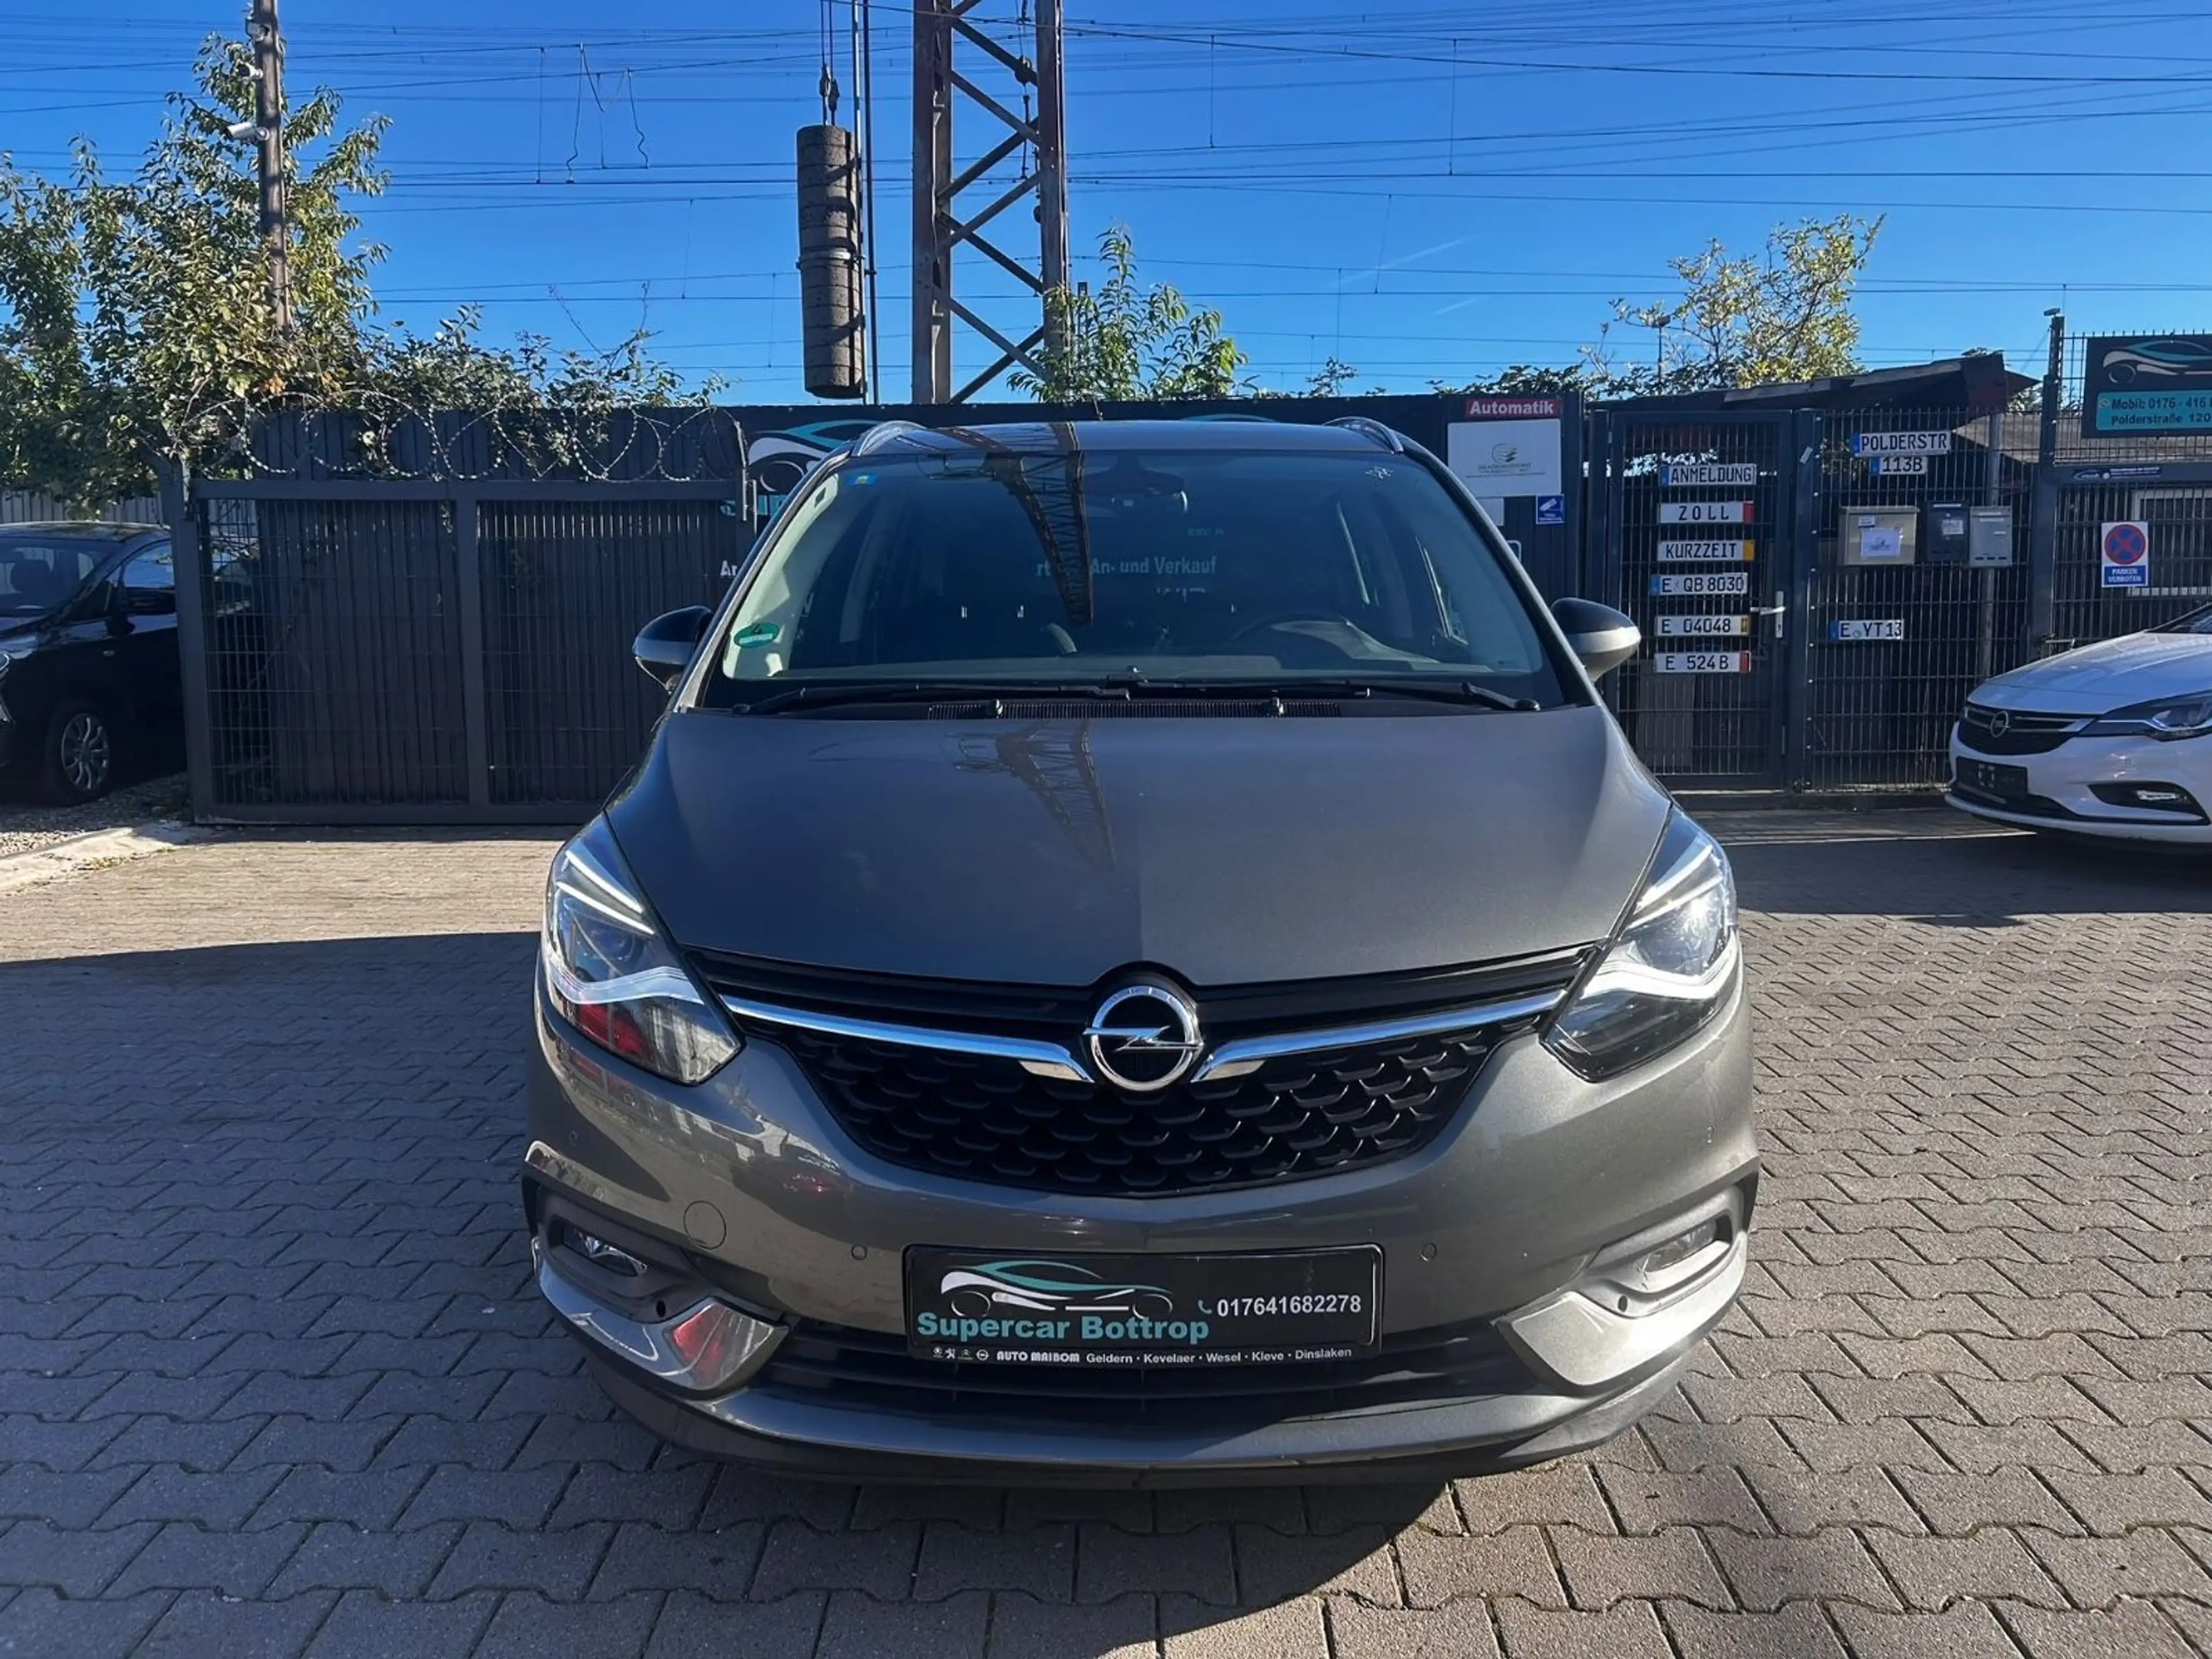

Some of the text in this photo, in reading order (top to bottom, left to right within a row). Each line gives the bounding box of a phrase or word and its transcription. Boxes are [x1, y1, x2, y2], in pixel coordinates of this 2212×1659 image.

[1469, 400, 1554, 415] Automatik
[2148, 397, 2176, 409] 0176
[1861, 433, 1947, 451] POLDERSTR
[1882, 457, 1923, 472] 113B
[1671, 467, 1752, 483] ANMELDUNG
[1678, 505, 1729, 521] ZOLL
[1665, 543, 1737, 559] KURZZEIT
[1154, 556, 1217, 575] Verkauf
[1662, 578, 1672, 592] E
[1684, 577, 1703, 592] QB
[1662, 619, 1671, 634] E
[1683, 618, 1730, 633] 04048
[1840, 623, 1850, 637] E
[1666, 656, 1675, 670] E
[1687, 656, 1715, 670] 524
[1217, 1296, 1361, 1317] 017641682278
[917, 1312, 1209, 1344] Supercar Bottrop
[997, 1351, 1028, 1361] AUTO
[1086, 1354, 1133, 1363] Geldern
[1143, 1354, 1195, 1363] Kevelaer
[1206, 1352, 1241, 1362] Wesel
[1296, 1348, 1351, 1359] Dinslaken
